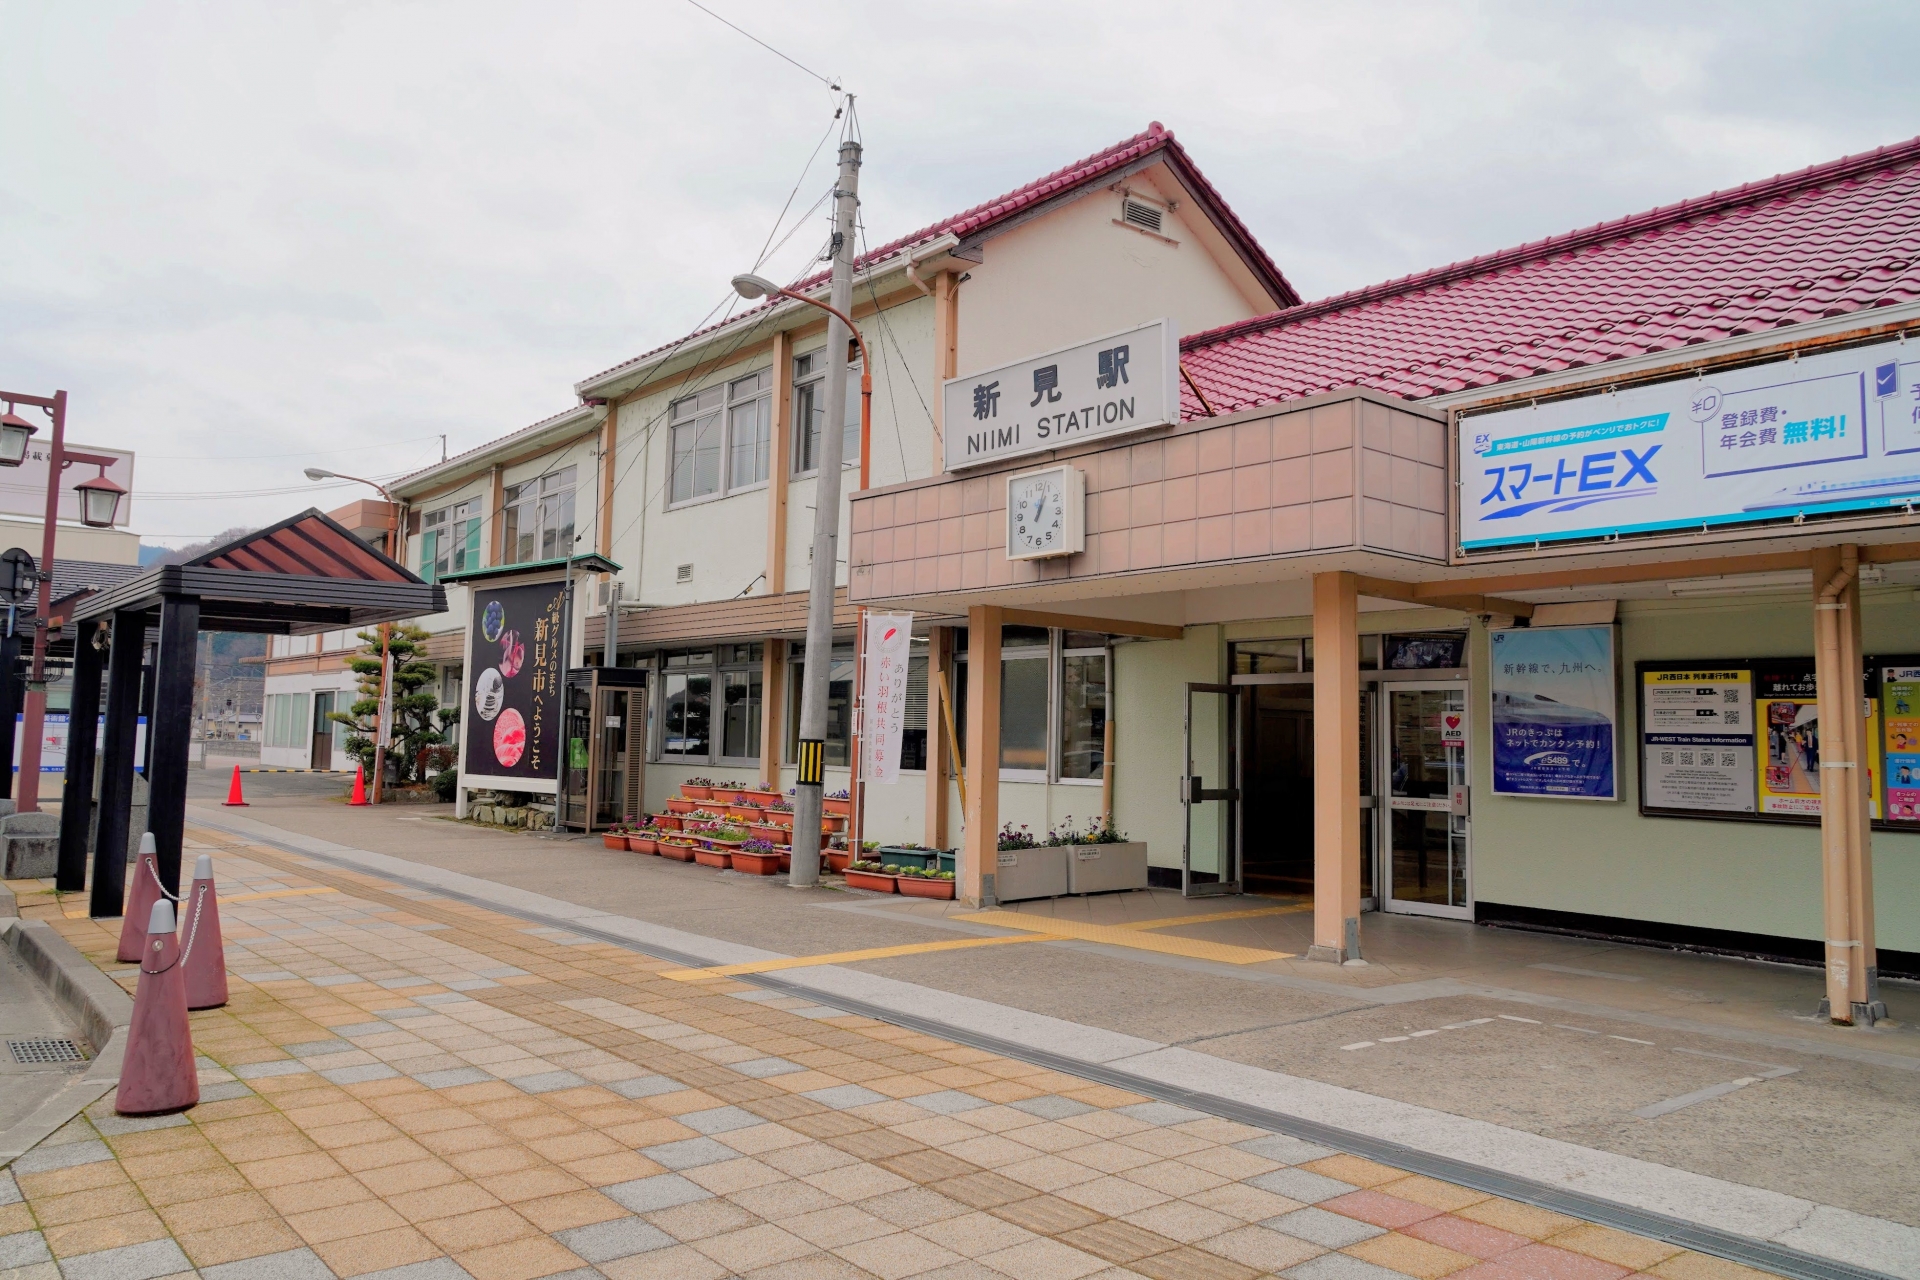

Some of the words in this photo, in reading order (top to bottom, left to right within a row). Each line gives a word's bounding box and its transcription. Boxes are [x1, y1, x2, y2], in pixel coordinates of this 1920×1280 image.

[972, 344, 1130, 421] 新見駅
[967, 423, 1020, 455] NIIMI
[1037, 396, 1135, 439] STATION
[1720, 428, 1777, 450] 年会費
[1783, 414, 1846, 445] 無料!
[1475, 432, 1490, 444] EX
[1479, 444, 1662, 506] スマートEX
[1035, 482, 1043, 491] 12
[1025, 490, 1033, 498] 11
[1052, 494, 1059, 502] 2
[1018, 500, 1028, 510] 10
[1055, 507, 1062, 515] 3
[1016, 513, 1024, 522] 9
[1052, 520, 1059, 528] 4
[1019, 525, 1026, 534] 8
[1026, 535, 1033, 544] 7
[1045, 532, 1052, 540] 5
[1035, 537, 1042, 546] 6
[1503, 662, 1602, 676] 新幹線で、九州へ。
[1657, 673, 1691, 681] JR西日本
[1693, 672, 1738, 680] 列車運行情報
[1773, 683, 1817, 692] 離れてお歩
[530, 617, 549, 770] 新見市へようこそ
[890, 663, 904, 734] ありがとう
[874, 656, 892, 778] 赤い羽根共同募金
[1506, 728, 1563, 738] JRのきっぷは
[1540, 756, 1568, 765] e5489
[1572, 759, 1587, 768] で。
